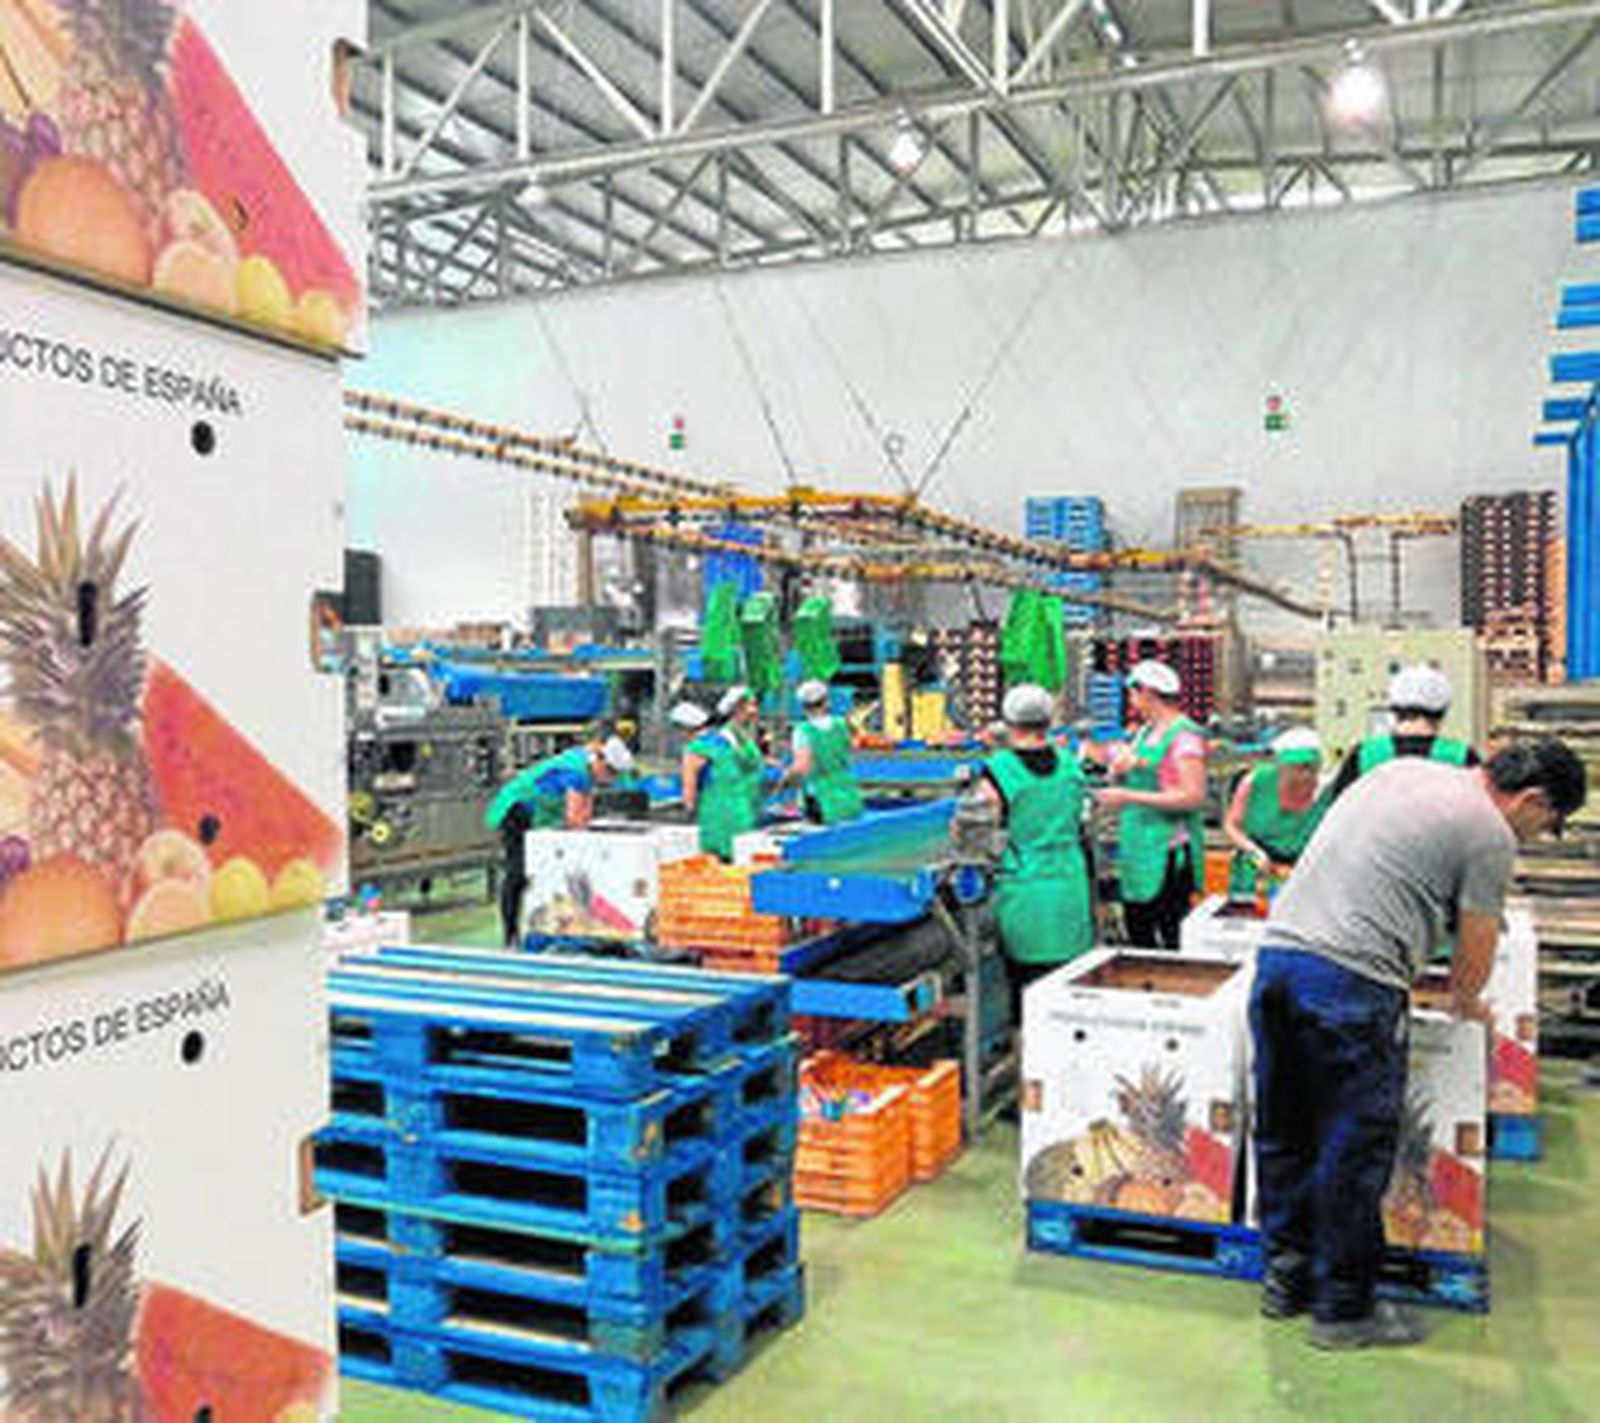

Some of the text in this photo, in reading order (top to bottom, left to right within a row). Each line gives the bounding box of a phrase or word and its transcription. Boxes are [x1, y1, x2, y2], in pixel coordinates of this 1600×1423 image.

[100, 355, 138, 393] DE
[143, 364, 243, 416] ESPAÑA
[0, 978, 230, 1071] CTOS DE ESPAÑA
